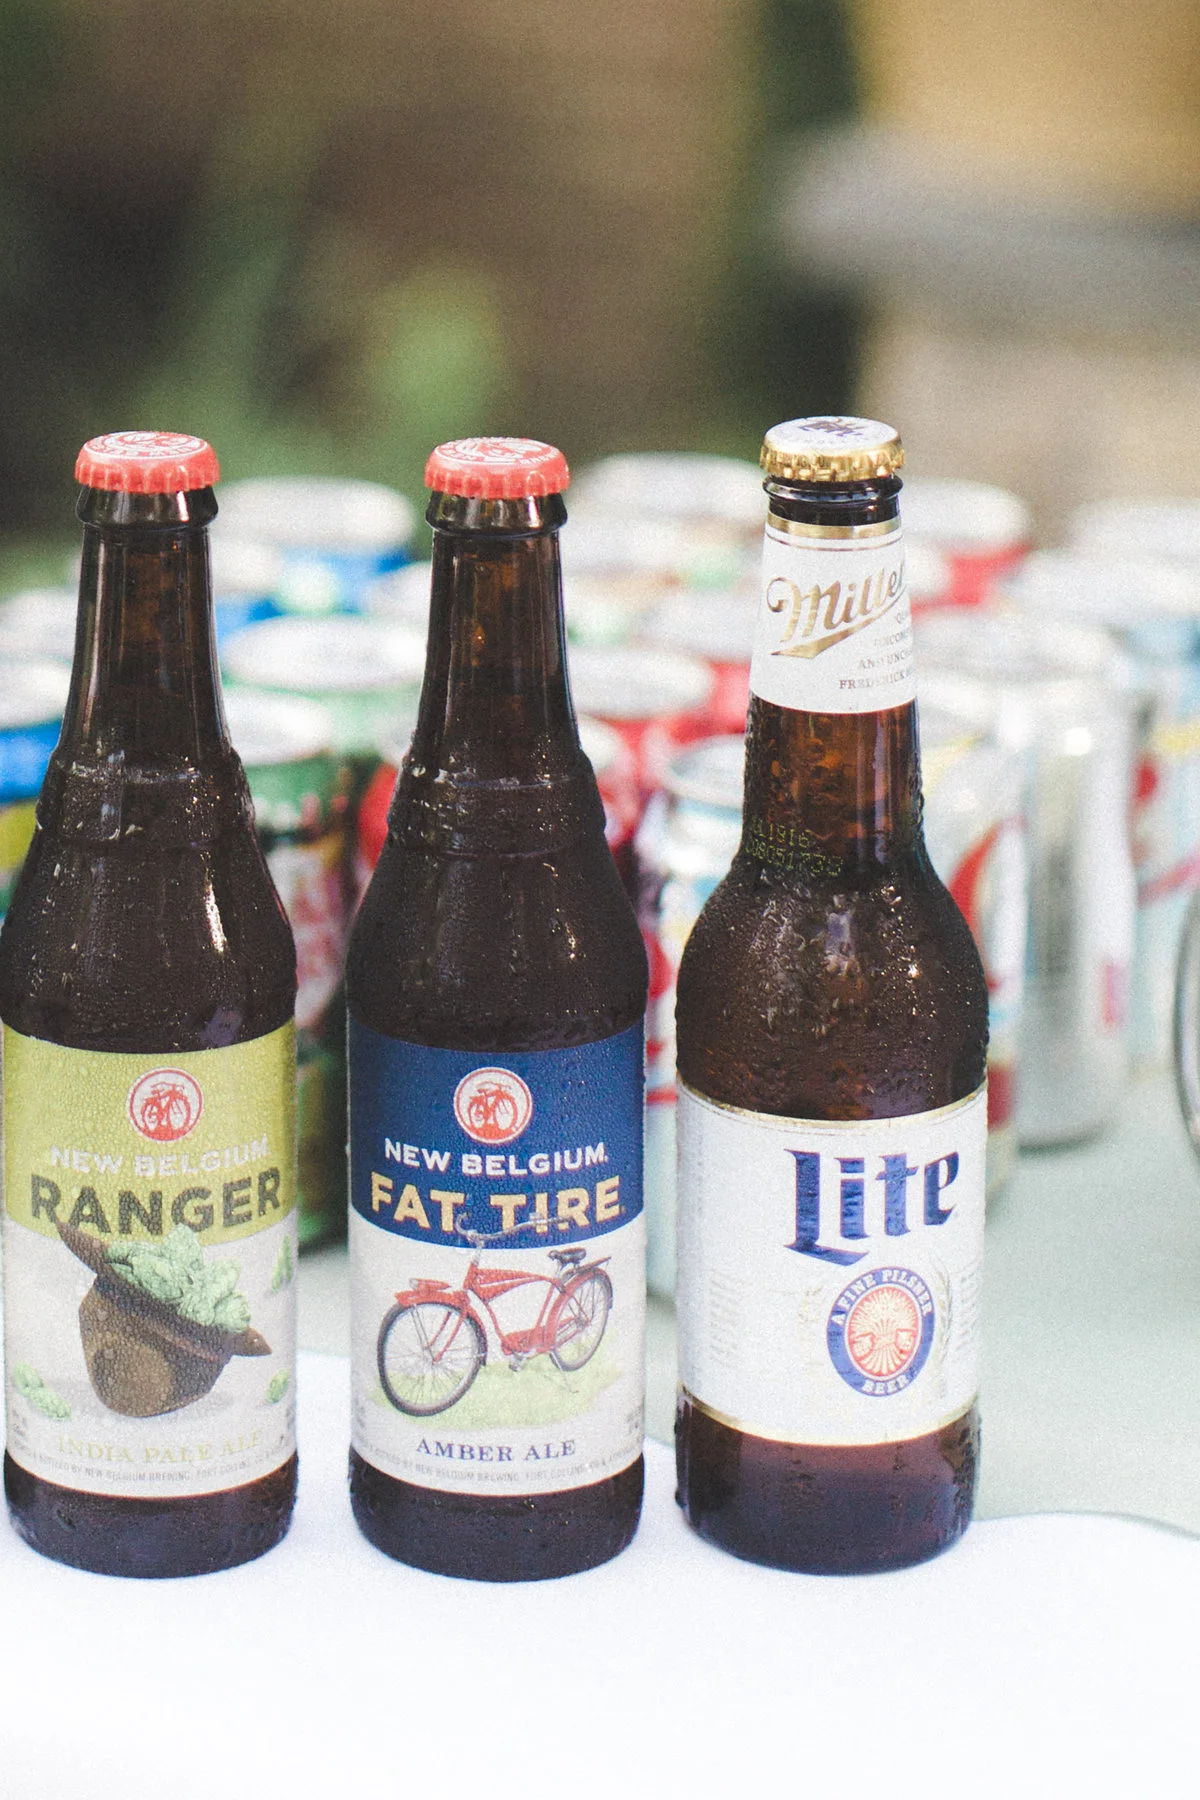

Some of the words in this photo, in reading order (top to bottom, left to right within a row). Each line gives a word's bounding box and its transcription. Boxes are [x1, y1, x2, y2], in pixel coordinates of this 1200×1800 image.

[50, 1146, 123, 1176] NEW
[134, 1136, 269, 1177] BELGIUM
[384, 1138, 452, 1172] NEW
[31, 1167, 281, 1236] RANGER
[370, 1171, 465, 1233] FAT
[490, 1175, 622, 1234] TIRE
[783, 1148, 959, 1267] Lite
[837, 1273, 877, 1310] FINE
[882, 1269, 932, 1317] PILSNER
[862, 1375, 910, 1395] BEER
[58, 1435, 135, 1463] INDIA
[144, 1442, 214, 1464] PALE
[219, 1428, 263, 1457] ALE
[415, 1438, 513, 1463] AMBER
[524, 1439, 576, 1461] ALE
